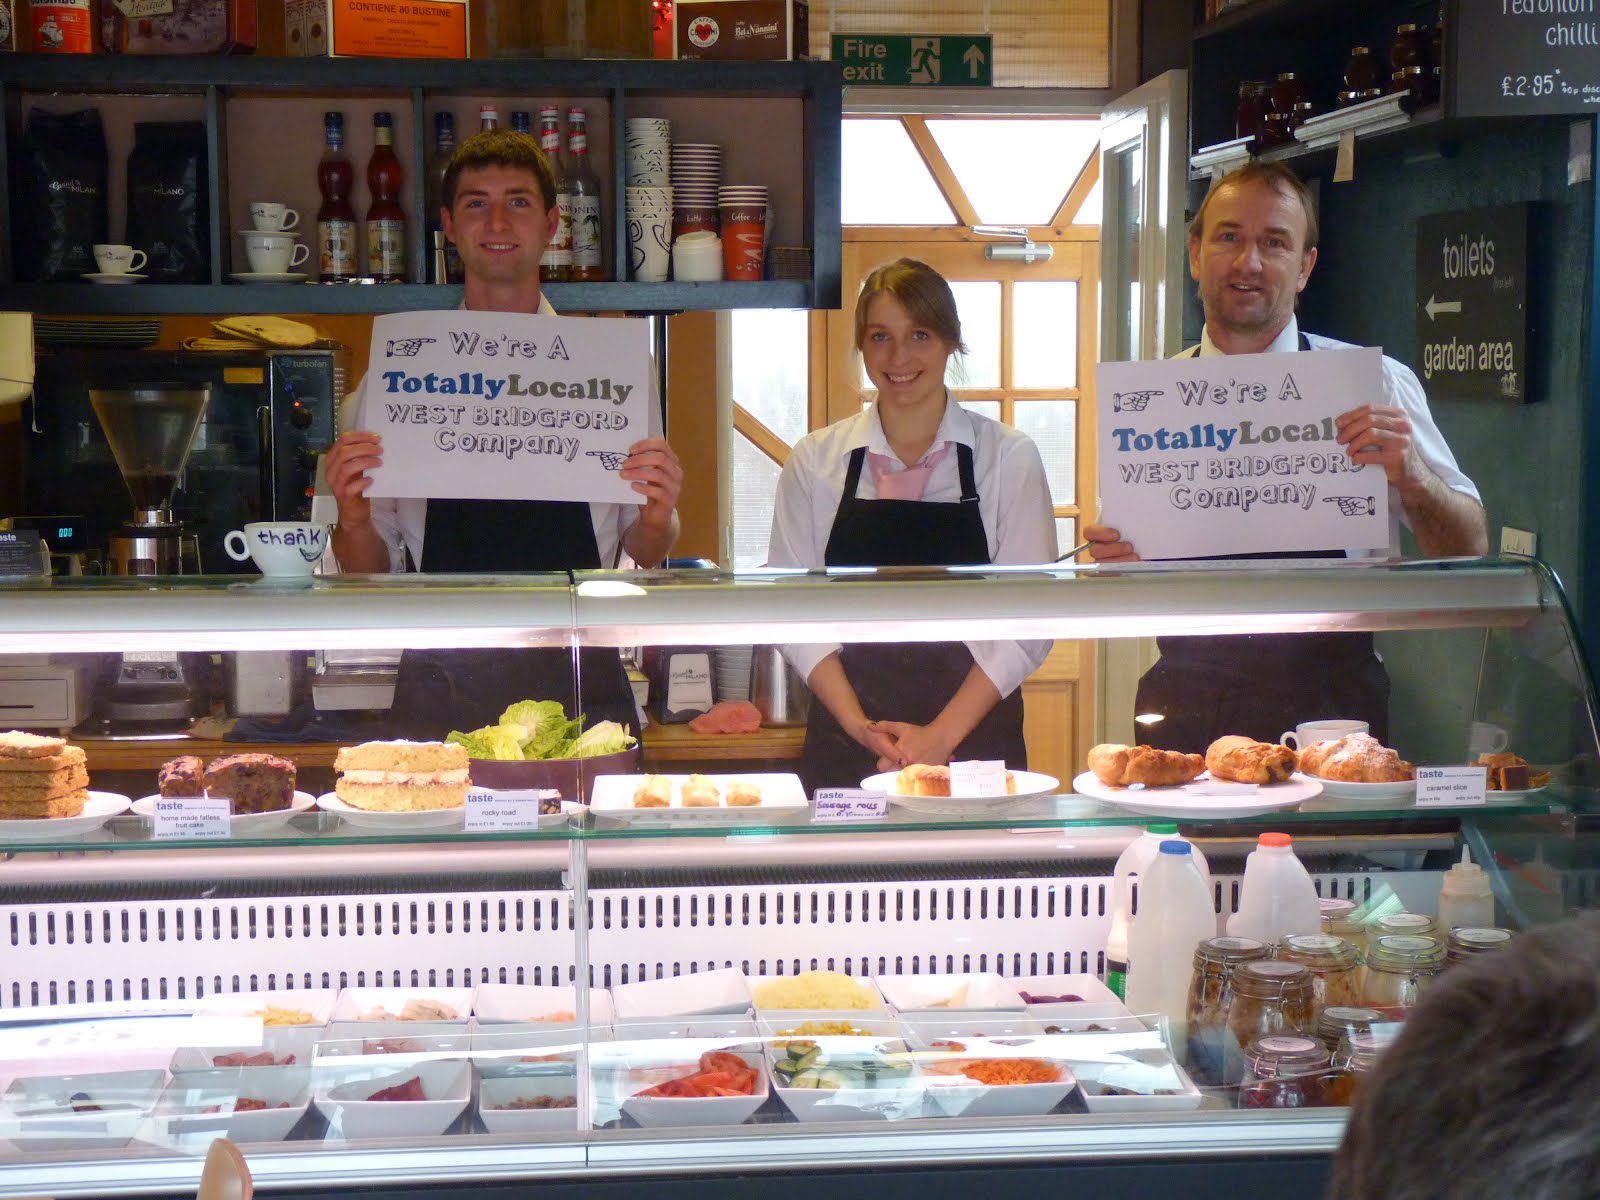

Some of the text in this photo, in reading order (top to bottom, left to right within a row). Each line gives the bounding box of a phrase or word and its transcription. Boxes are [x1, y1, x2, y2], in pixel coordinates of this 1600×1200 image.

[348, 2, 396, 13] CONTIENE
[412, 7, 451, 17] BUSTINE
[1545, 22, 1599, 46] chilli
[843, 39, 887, 58] Fire
[842, 62, 885, 80] exit
[731, 212, 751, 222] Coffee
[1443, 233, 1495, 279] toilets
[449, 331, 570, 361] We're A
[1424, 336, 1514, 380] garden area
[1176, 372, 1303, 407] We're A
[385, 403, 629, 431] WEST BRIDGFORD
[433, 426, 580, 463] Company
[1119, 460, 1199, 484] WEST
[1169, 482, 1317, 513] Company
[1419, 770, 1444, 779] taste
[156, 802, 183, 810] taste
[467, 794, 493, 802] taste
[816, 801, 852, 812] Sausage
